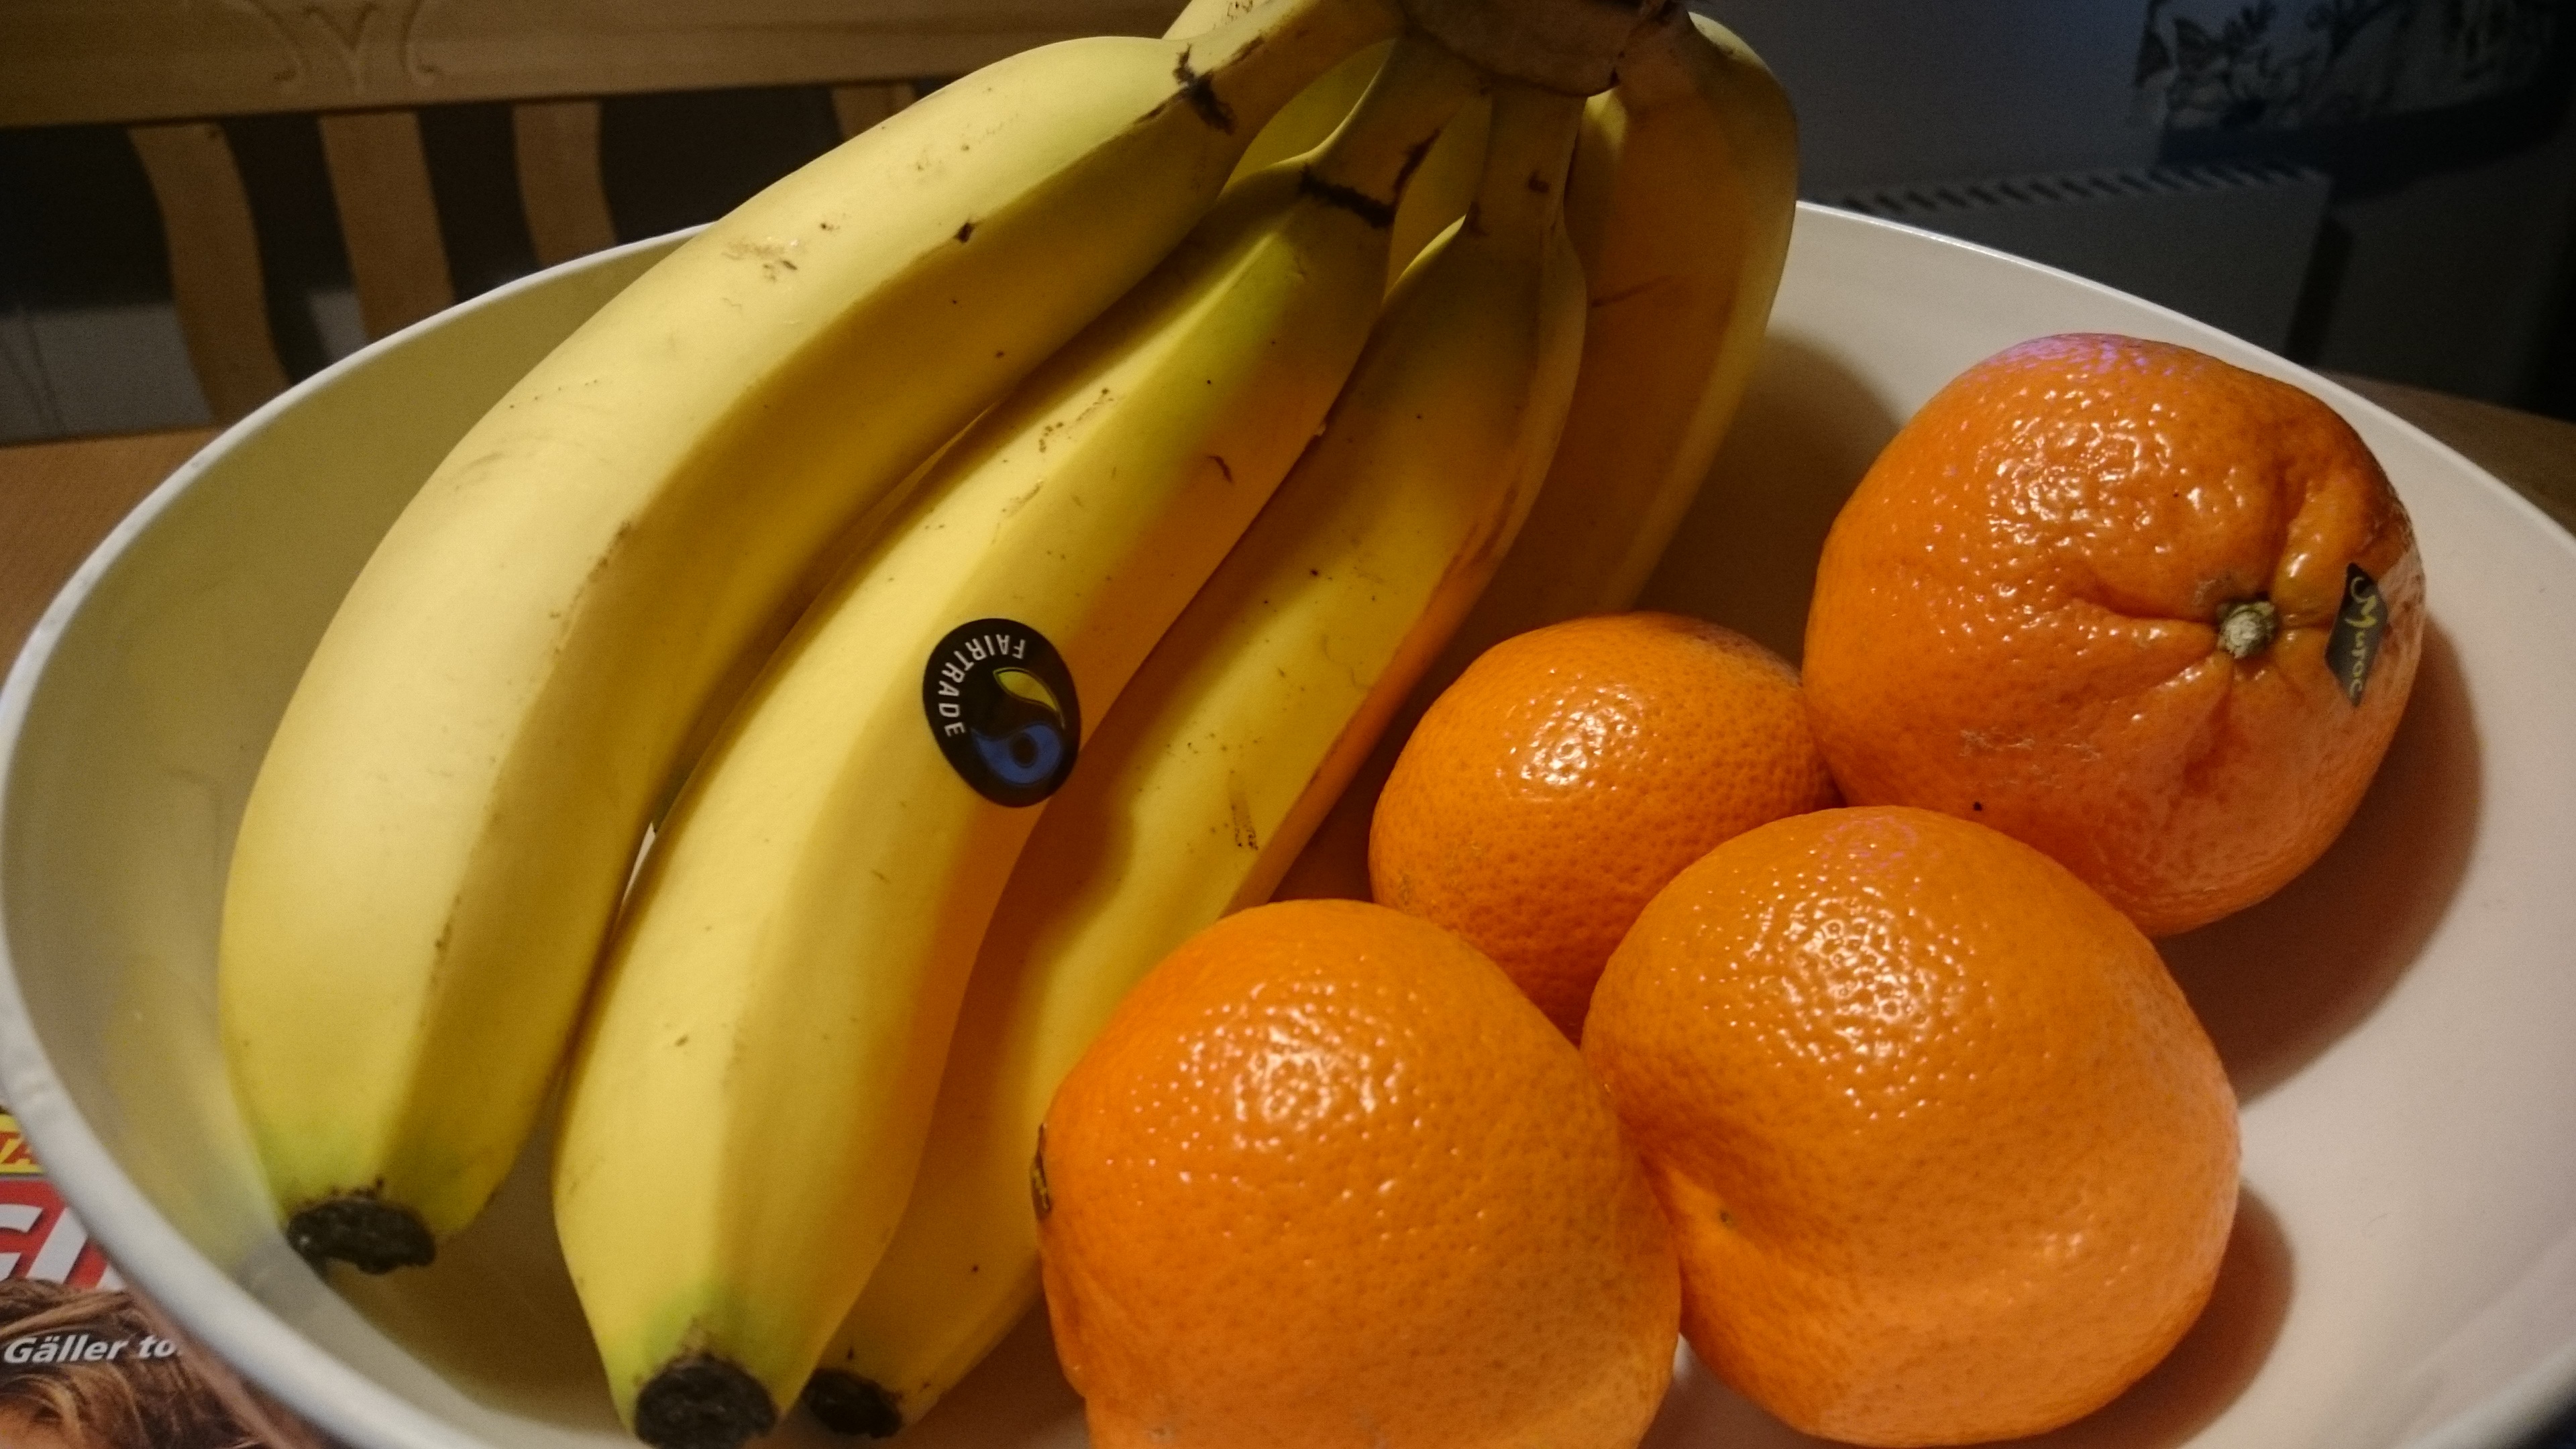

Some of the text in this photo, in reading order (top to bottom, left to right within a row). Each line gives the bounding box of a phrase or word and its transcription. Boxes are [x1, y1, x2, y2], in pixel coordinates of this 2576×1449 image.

[937, 634, 1026, 737] FAIRTRADE
[3, 1334, 182, 1364] Gäller to
